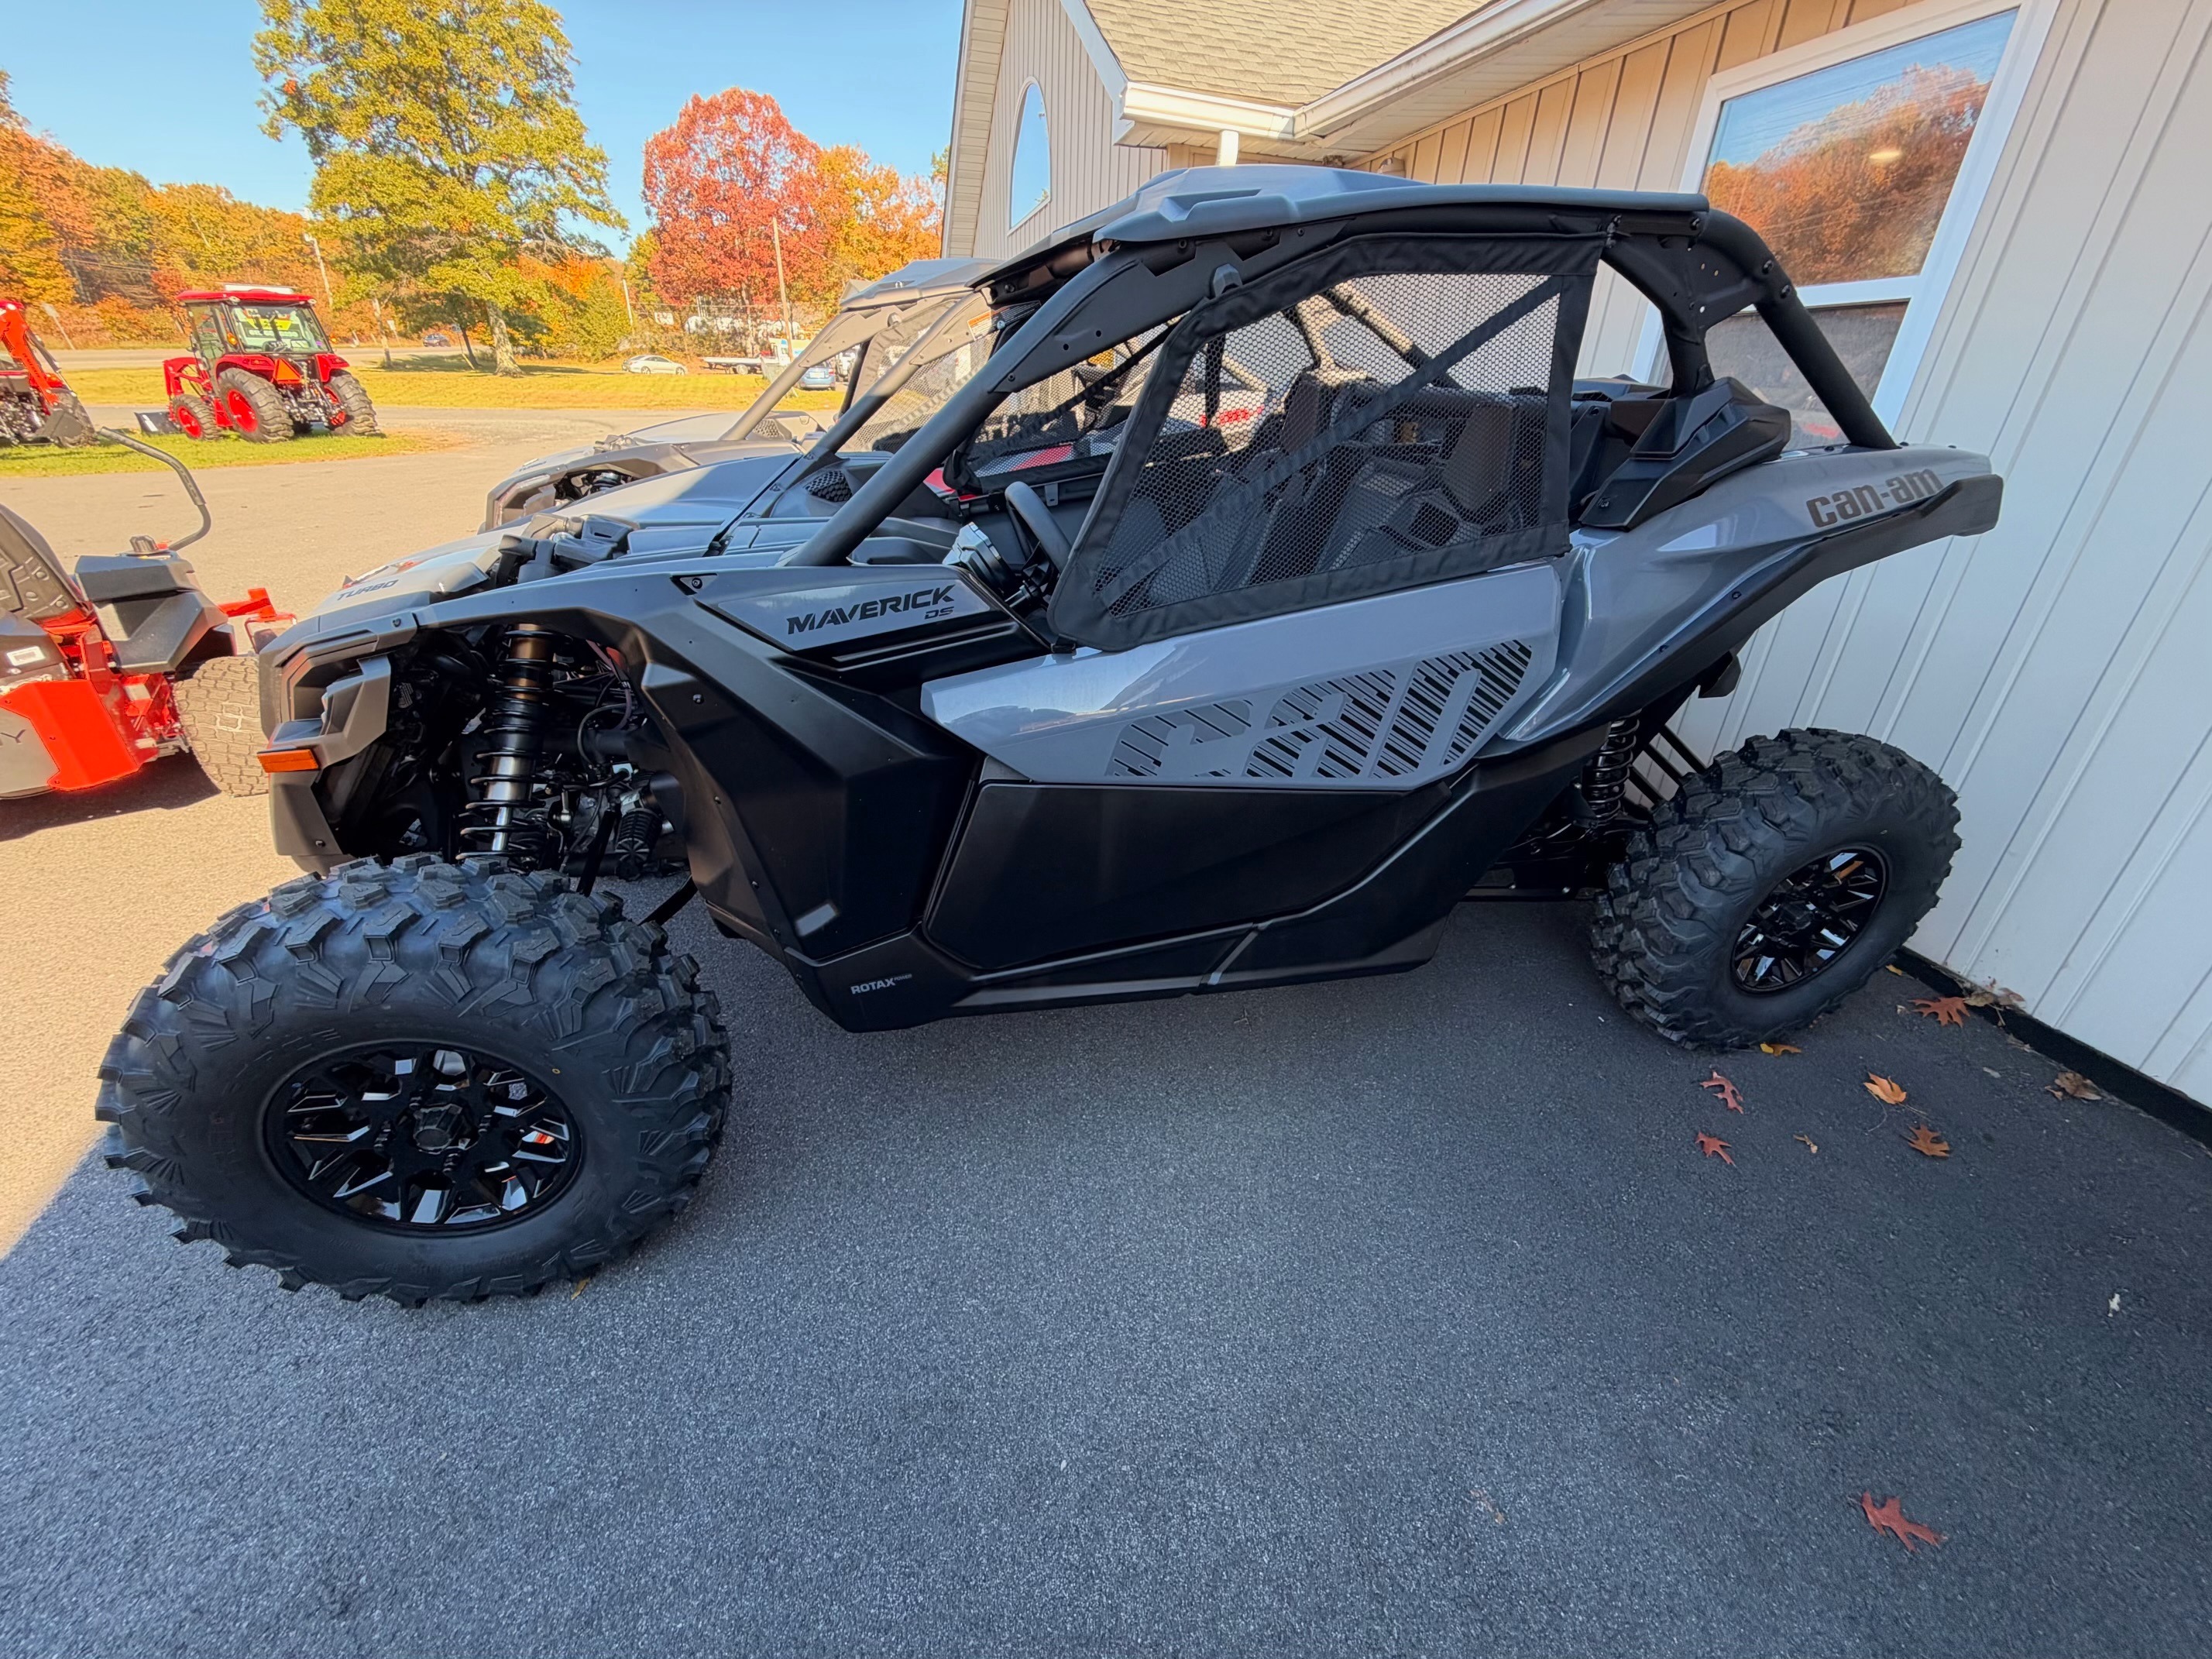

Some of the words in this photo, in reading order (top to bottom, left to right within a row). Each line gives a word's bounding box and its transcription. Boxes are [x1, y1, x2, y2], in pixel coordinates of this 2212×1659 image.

[1806, 469, 1944, 528] can-am
[338, 579, 399, 600] TURBO
[786, 585, 955, 634] MAVERICK
[924, 606, 955, 620] DS
[850, 977, 896, 994] ROTAX
